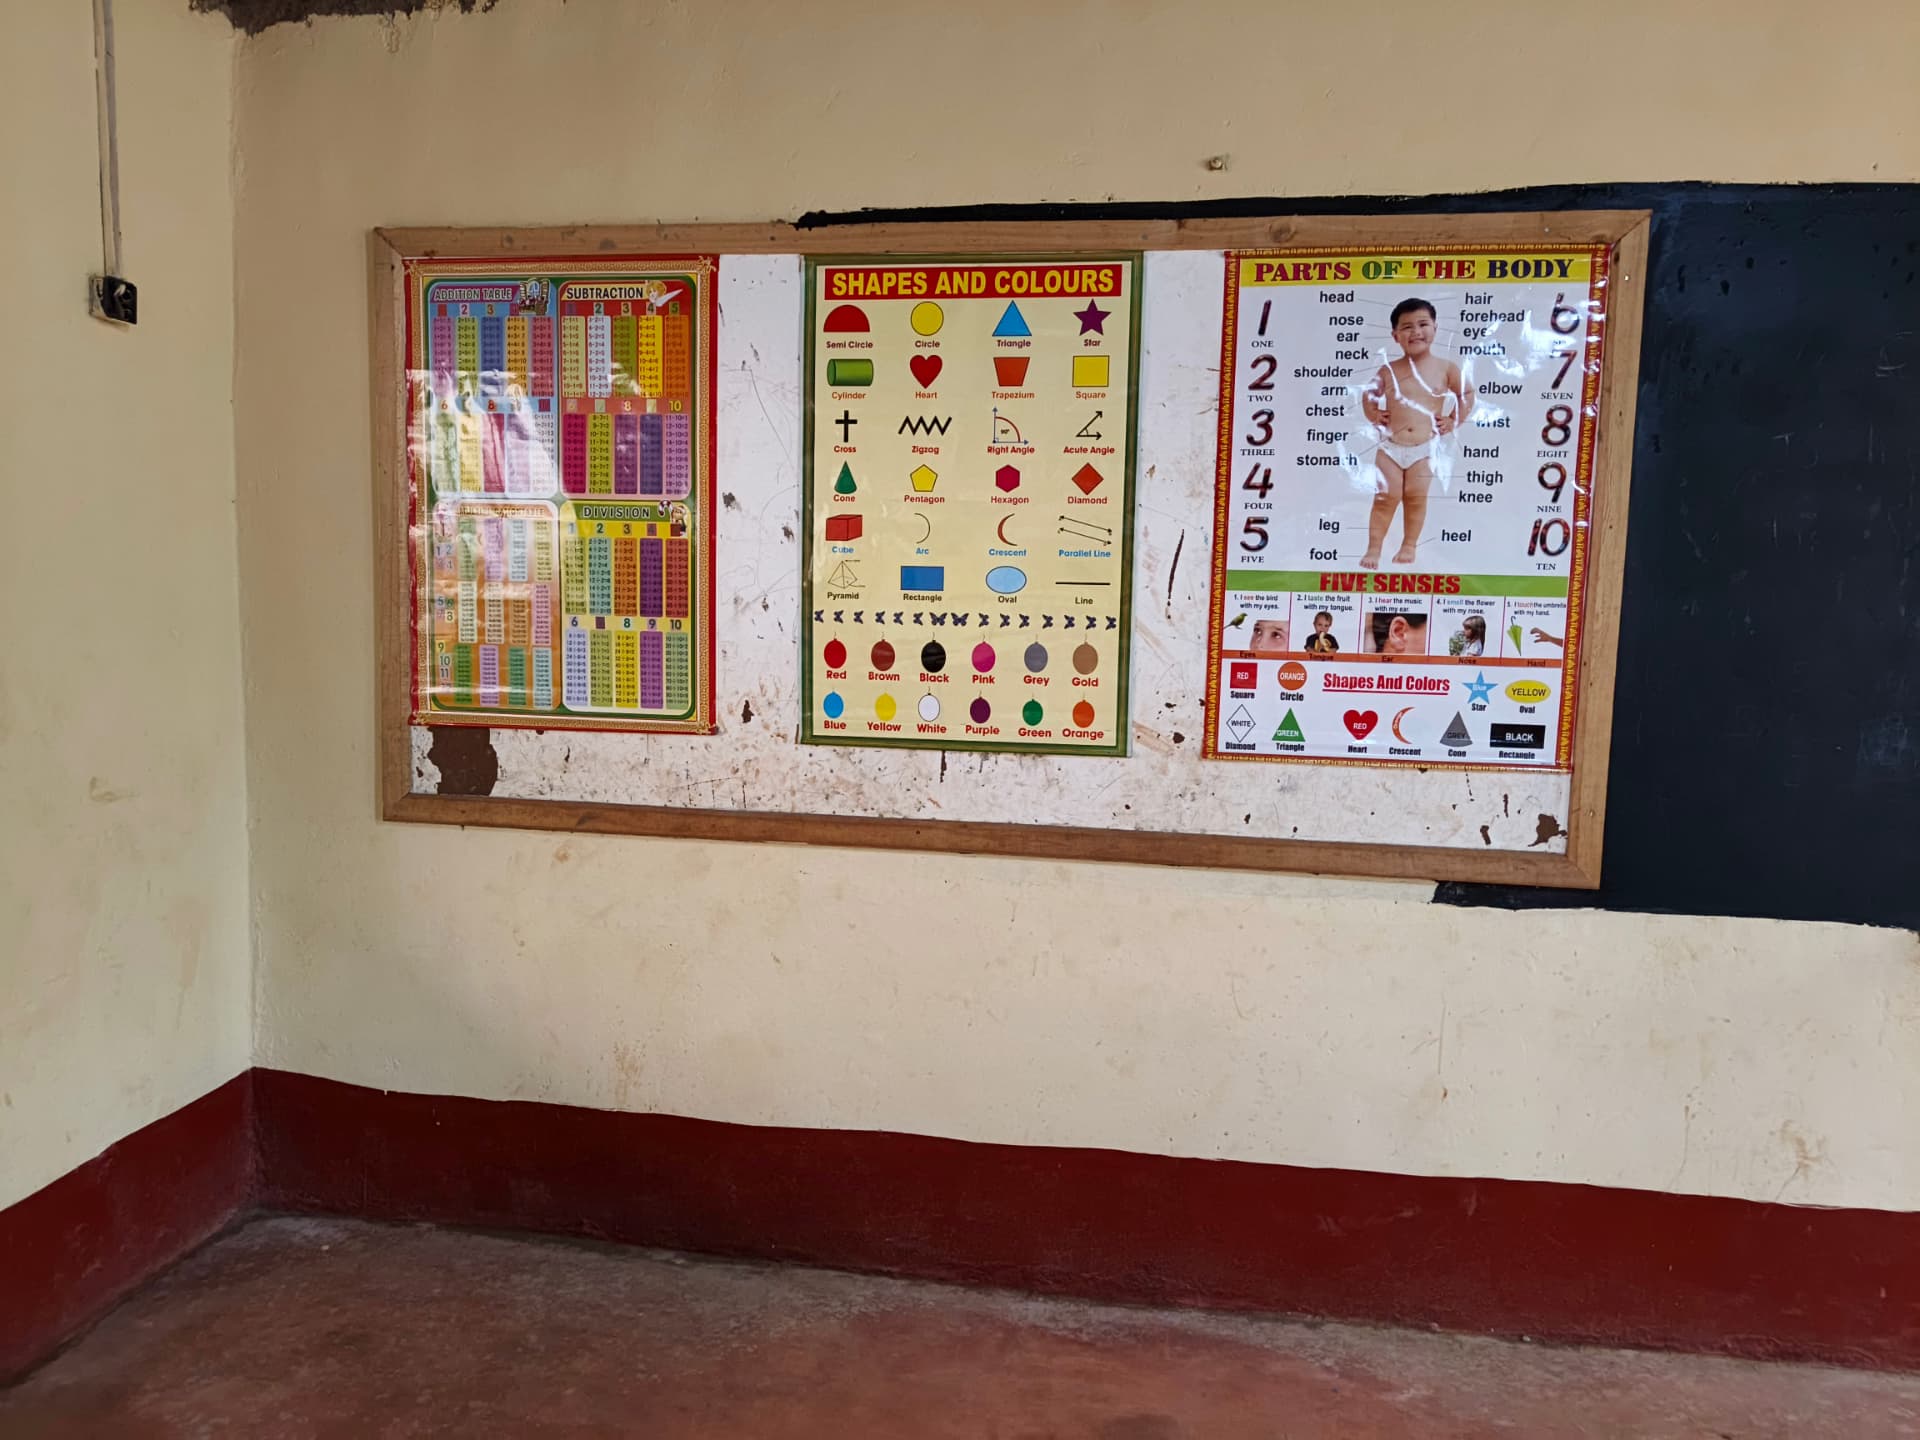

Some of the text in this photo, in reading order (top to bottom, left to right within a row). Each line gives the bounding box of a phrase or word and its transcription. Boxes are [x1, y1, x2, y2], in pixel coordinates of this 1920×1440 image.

[1254, 258, 1575, 282] PARTS OF THE BODY
[832, 269, 1113, 295] SHAPES AND COLOURS
[434, 288, 512, 300] ADDITION TABLE
[566, 287, 643, 299] SUBTRACTION
[1320, 290, 1354, 303] head
[1465, 292, 1493, 305] hair
[462, 304, 494, 315] 2 3
[595, 304, 602, 313] 2
[623, 303, 630, 313] 3
[1551, 292, 1580, 334] 6
[1258, 300, 1272, 336] 1
[1329, 316, 1363, 326] nose
[1460, 310, 1525, 322] forehead
[1337, 332, 1359, 342] ear
[826, 340, 873, 348] Semi Circle
[915, 340, 940, 348] Circle
[997, 339, 1031, 349] Triangle
[1084, 339, 1100, 347] Star
[1335, 348, 1368, 360] neck
[1459, 343, 1506, 356] mouth
[1248, 354, 1277, 390] 2
[1294, 366, 1353, 378] shoulder
[1549, 350, 1577, 390] 7
[1321, 386, 1348, 396] arm
[1479, 382, 1522, 394] elbow
[832, 391, 866, 400] Cylinder
[915, 391, 937, 399] Heart
[992, 391, 1034, 400] Trapezium
[1076, 391, 1106, 400] Square
[1541, 392, 1573, 400] SEVEN
[624, 401, 681, 411] 8 10
[1306, 404, 1344, 417] chest
[1246, 408, 1274, 446] 3
[1542, 404, 1573, 447] 8
[1307, 429, 1348, 444] finger
[988, 446, 1035, 455] Right Angle
[1063, 446, 1115, 456] Acute Angle
[1464, 445, 1499, 458] hand
[1537, 450, 1568, 458] EIGHT
[1297, 454, 1358, 466] stomah
[1242, 462, 1273, 499] 4
[1467, 470, 1503, 486] thigh
[1538, 462, 1567, 503] 9
[904, 495, 944, 504] Pentagon
[991, 496, 1029, 505] Hexagon
[1068, 496, 1107, 504] Diamond
[1459, 490, 1493, 503] knee
[1244, 502, 1272, 510] FOUR
[584, 506, 650, 517] DIVISION
[596, 523, 630, 534] 2 3
[1319, 518, 1340, 533] leg
[1240, 517, 1269, 552] 5
[1441, 529, 1471, 542] heel
[1528, 518, 1570, 556] 10
[832, 546, 854, 554] Cube
[916, 547, 929, 555] Arc
[989, 548, 1027, 556] Crescent
[1092, 550, 1111, 558] Line
[1310, 548, 1338, 561] foot
[1320, 572, 1461, 595] FIVE SENSES
[827, 592, 859, 601] Pyramid
[903, 593, 942, 603] Rectangle
[998, 596, 1017, 604] Oval
[1075, 596, 1093, 605] Line
[571, 617, 682, 630] 6 8 9 10
[440, 656, 450, 665] 10
[826, 670, 846, 679] Red
[868, 672, 900, 681] Brown
[920, 673, 949, 683] Black
[972, 674, 995, 684] Pink
[1237, 672, 1249, 680] RED
[1280, 672, 1304, 681] ORANGE
[1023, 675, 1049, 686] Grey
[1072, 677, 1098, 687] Gold
[1323, 673, 1450, 691] Shapes And Colors
[1230, 691, 1255, 699] Square
[1280, 692, 1304, 701] Circle
[1512, 687, 1546, 697] YELLOW
[1472, 703, 1487, 711] Star
[1519, 705, 1535, 714] Oval
[824, 720, 846, 729] Blue
[867, 721, 901, 732] Yellow
[917, 724, 947, 733] White
[1353, 722, 1367, 730] RED
[965, 725, 1000, 737] Purple
[1018, 728, 1051, 737] Green
[1062, 729, 1104, 741] Orange
[1506, 732, 1533, 742] BLACK
[1225, 742, 1256, 750] Diamond
[1276, 742, 1304, 752] Triangle
[1348, 745, 1367, 754] Heart
[1389, 747, 1421, 756] Crescent
[1448, 750, 1466, 758] Cone
[1499, 750, 1535, 759] Rectangle
